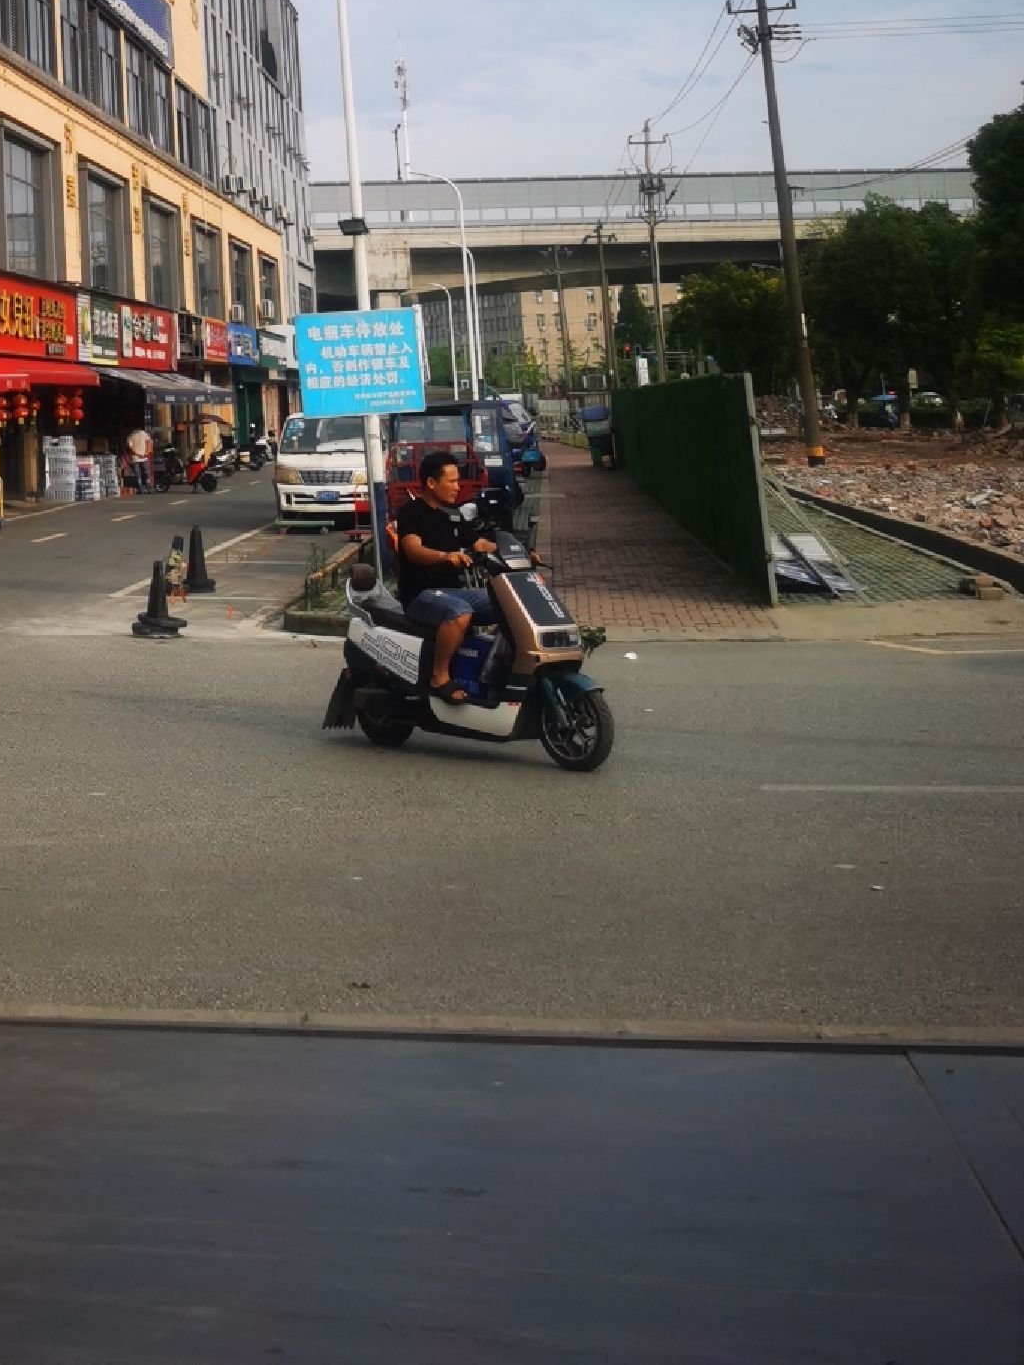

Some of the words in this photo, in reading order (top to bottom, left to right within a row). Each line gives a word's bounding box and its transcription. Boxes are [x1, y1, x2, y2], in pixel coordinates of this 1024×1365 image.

[308, 320, 404, 341] 电瓶车停放处
[322, 342, 413, 359] 机动车辆禁止入
